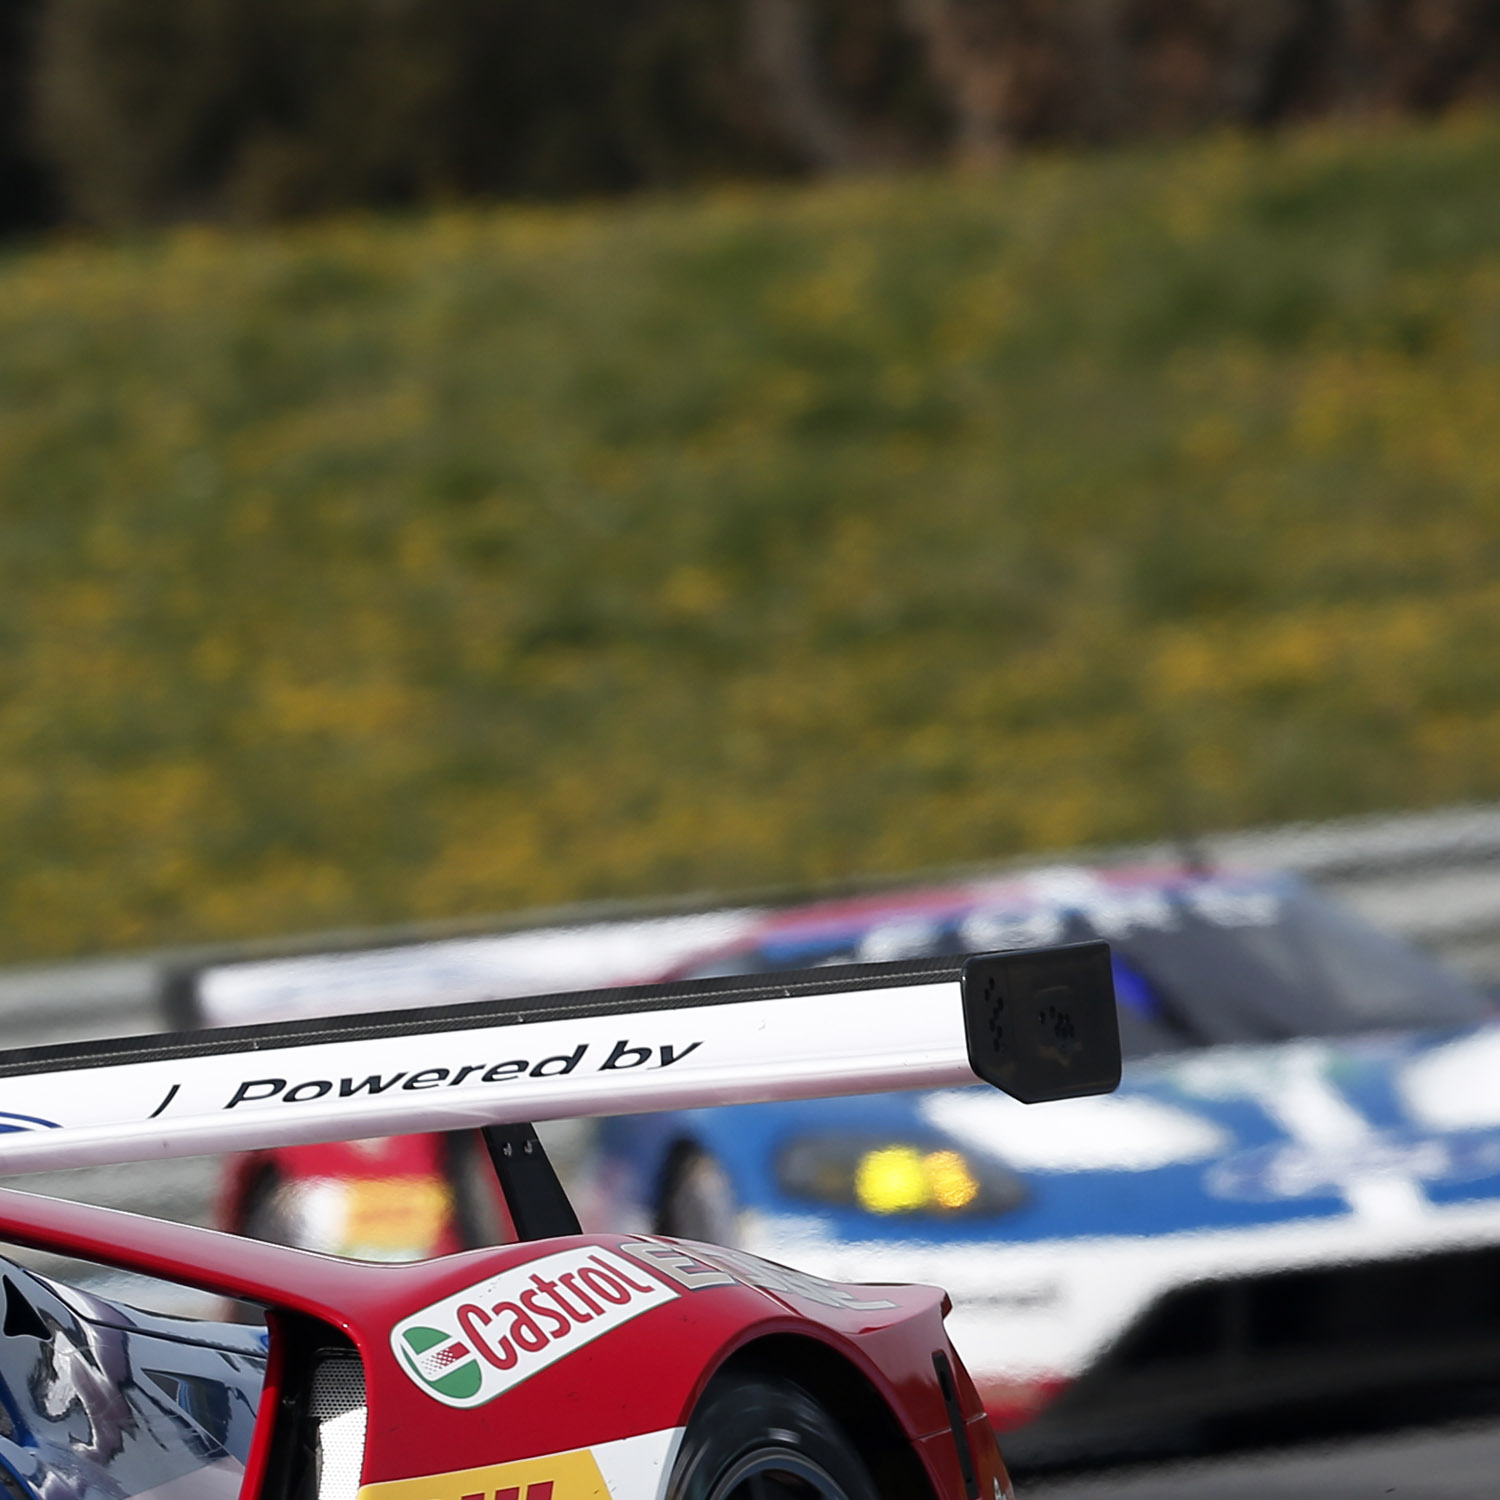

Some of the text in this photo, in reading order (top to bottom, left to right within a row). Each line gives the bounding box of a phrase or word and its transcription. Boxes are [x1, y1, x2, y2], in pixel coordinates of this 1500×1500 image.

[224, 1040, 704, 1109] Powered by
[456, 1267, 654, 1374] Castrol
